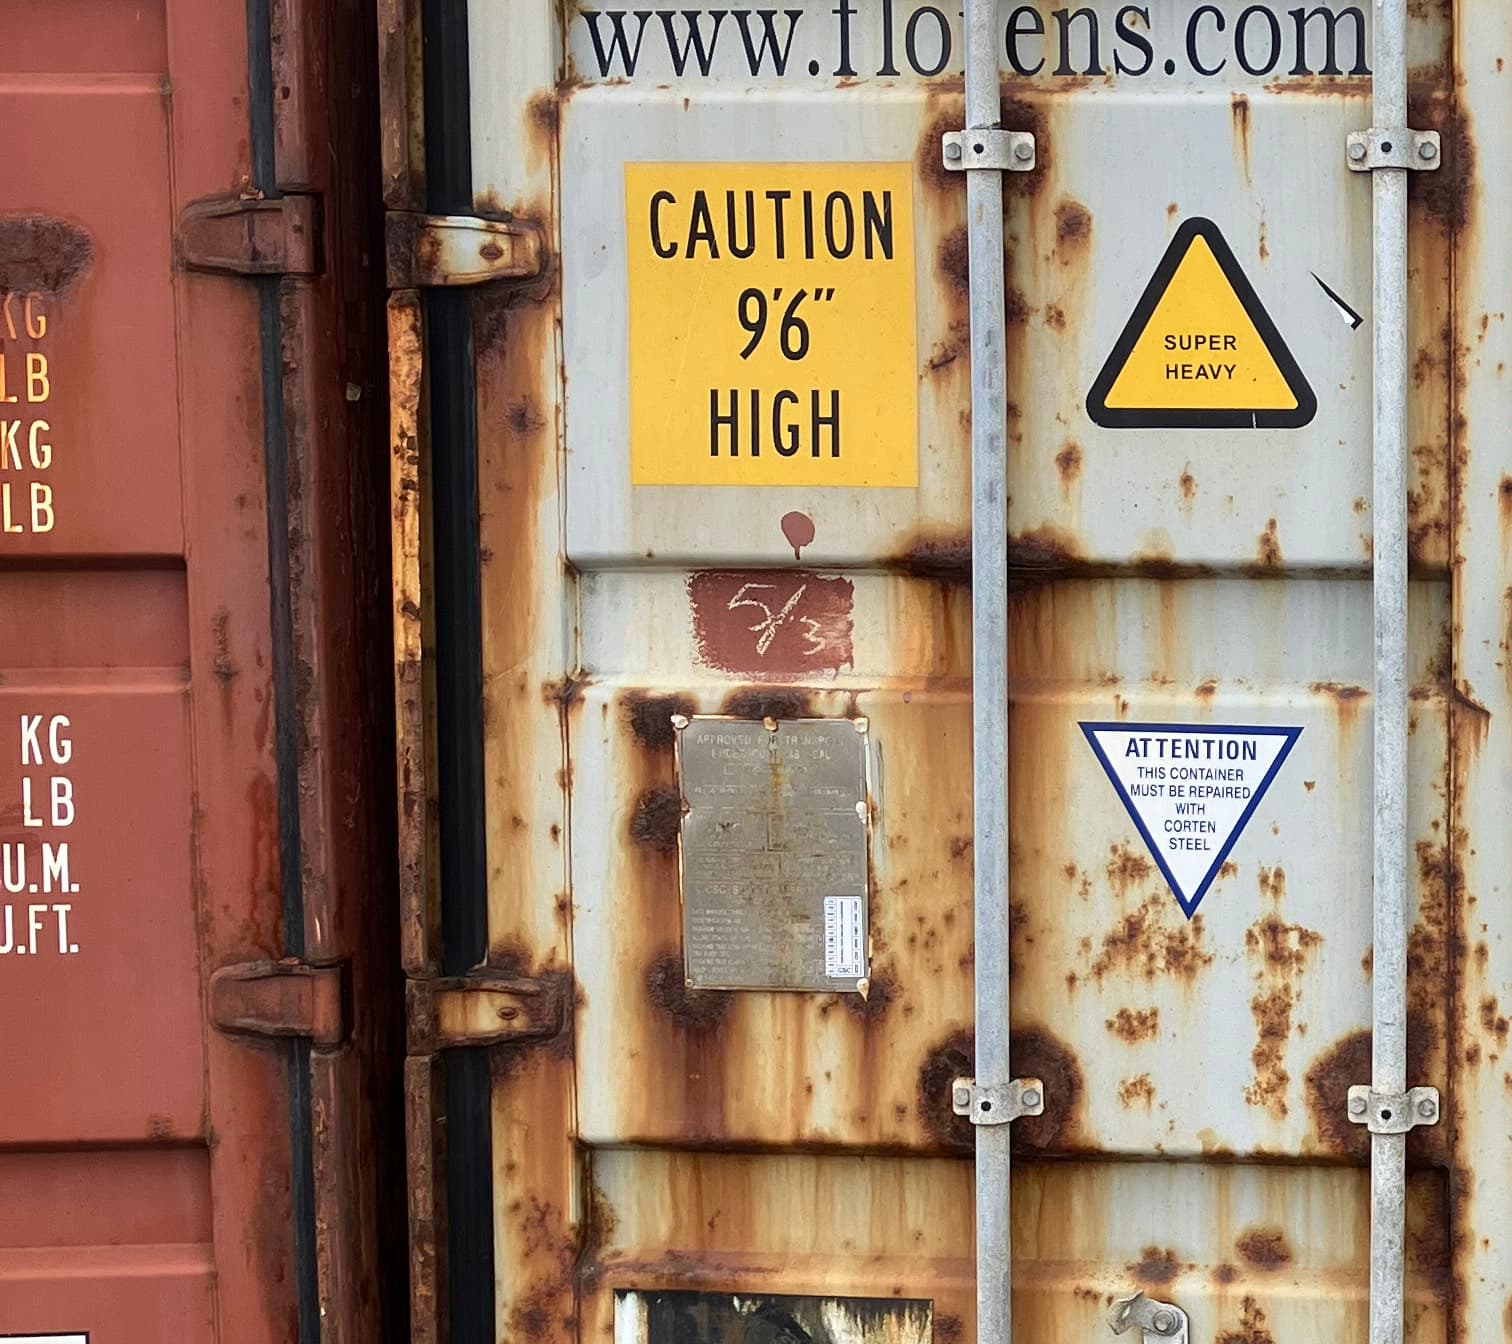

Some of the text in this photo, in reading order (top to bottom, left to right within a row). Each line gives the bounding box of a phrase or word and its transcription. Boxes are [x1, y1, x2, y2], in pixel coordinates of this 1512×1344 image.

[649, 190, 894, 259] CAUTION
[1164, 335, 1237, 352] SUPER
[0, 353, 50, 402] LB
[1164, 364, 1237, 381] HEAVY
[710, 390, 840, 458] HIGH
[0, 420, 52, 470] KG
[2, 482, 55, 533] LB
[21, 714, 72, 765] KG
[1125, 738, 1257, 760] ATTENTION
[1130, 784, 1250, 799] MUST BE REPAIRED
[1137, 767, 1244, 781] THIS CONTAINER
[22, 776, 75, 827] LB
[1175, 803, 1205, 815] WITH
[1164, 820, 1216, 833] CORTEN
[1169, 838, 1211, 851] STEEL
[0, 843, 80, 893] U.M.
